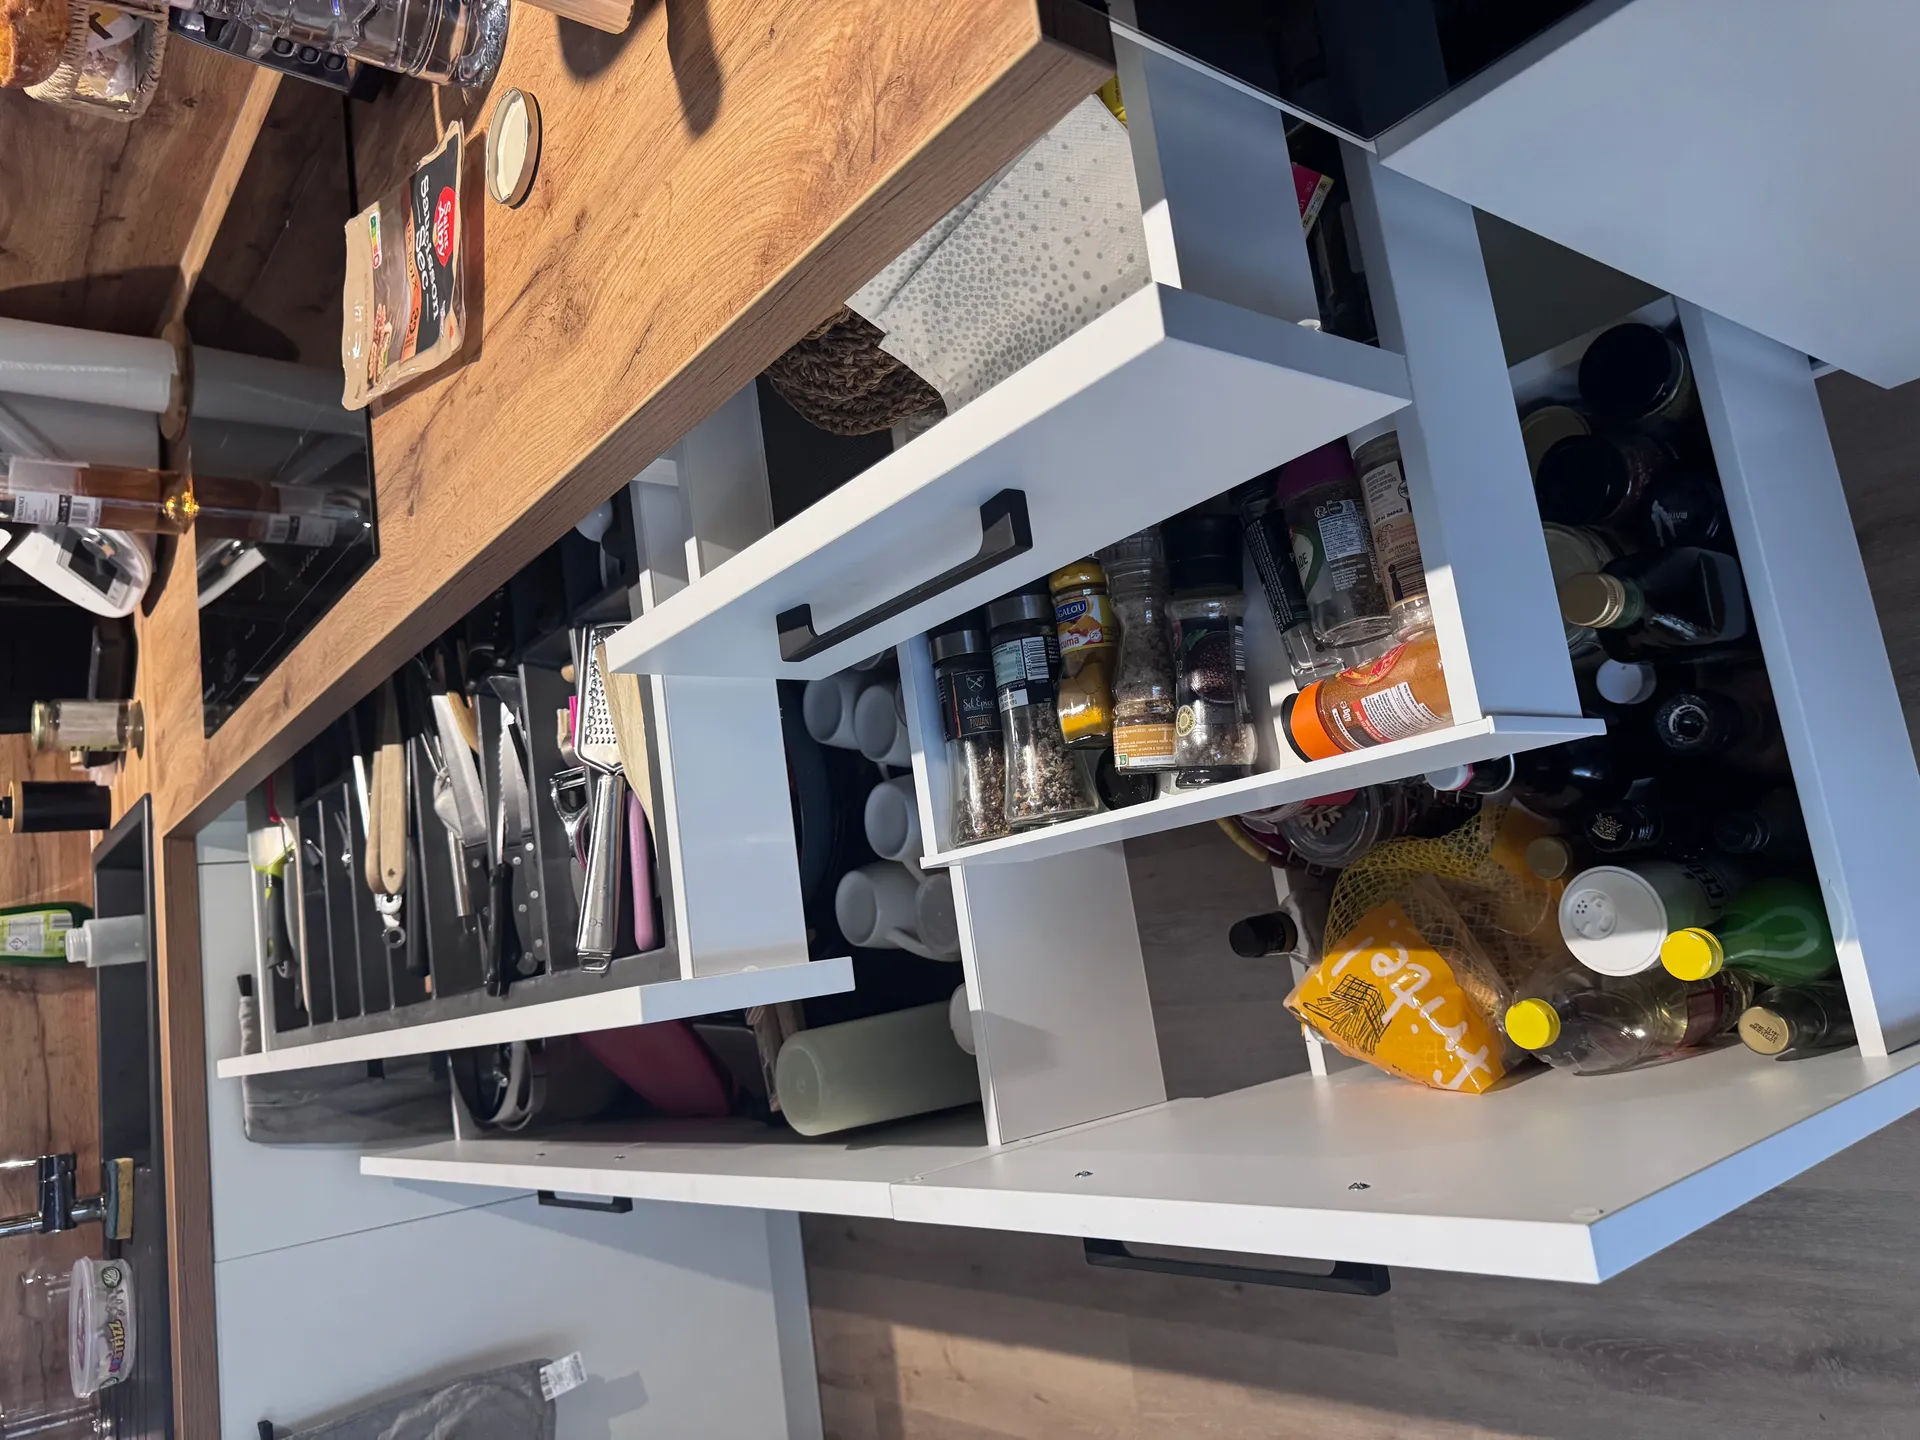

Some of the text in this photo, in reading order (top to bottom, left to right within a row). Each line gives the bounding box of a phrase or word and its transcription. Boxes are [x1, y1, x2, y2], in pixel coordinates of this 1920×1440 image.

[420, 175, 440, 321] Saucisson
[437, 202, 446, 257] Alby
[442, 200, 452, 249] Saint
[415, 225, 429, 290] Sec
